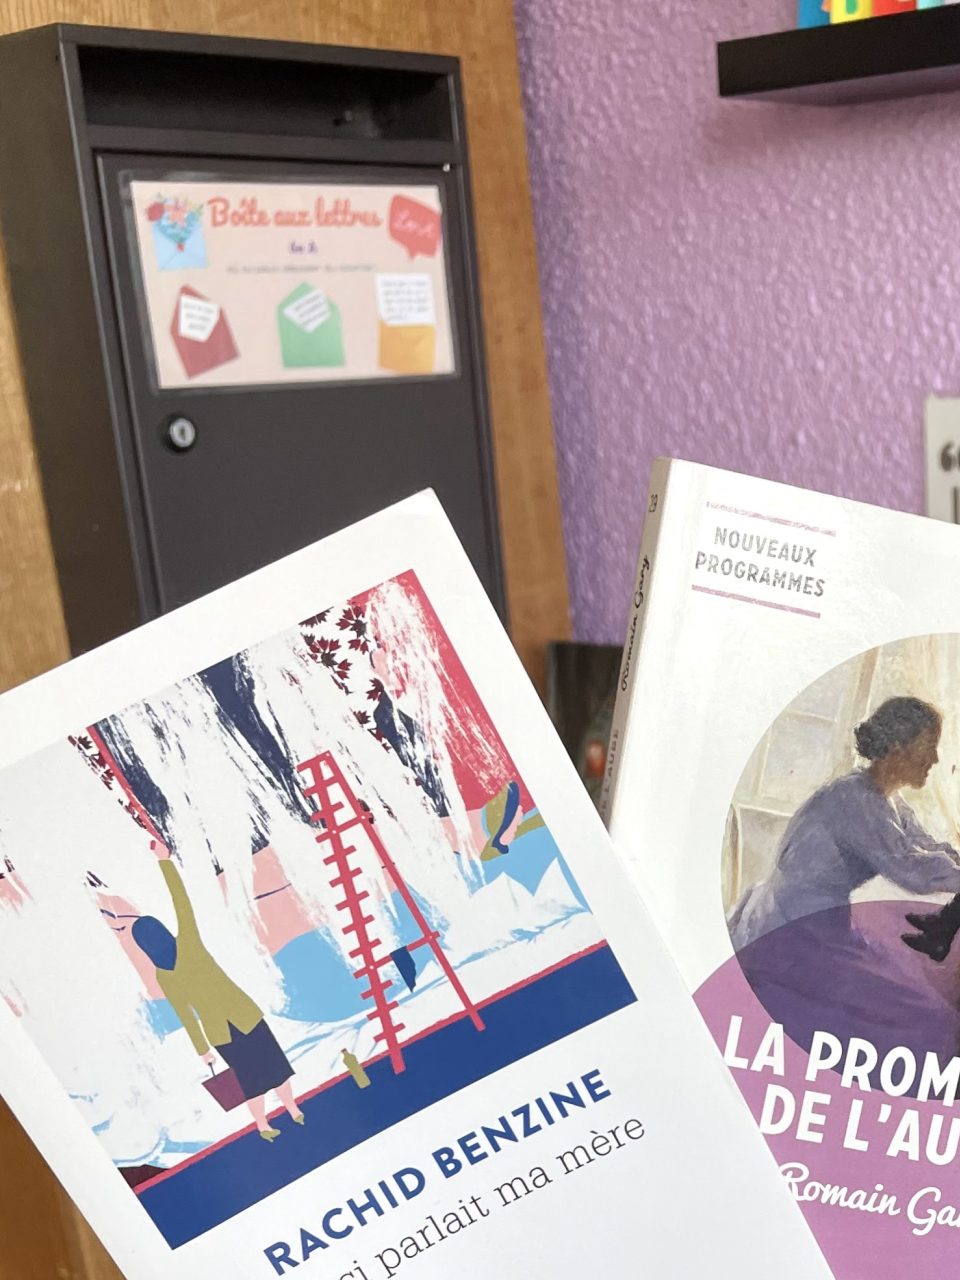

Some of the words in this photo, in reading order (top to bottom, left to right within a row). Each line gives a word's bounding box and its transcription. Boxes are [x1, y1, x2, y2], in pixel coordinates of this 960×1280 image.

[208, 196, 270, 227] Boîte
[274, 209, 312, 227] aux
[315, 195, 382, 227] lettres
[694, 551, 826, 598] PROGRAMMES
[714, 526, 817, 567] NOUVEAUX
[620, 612, 639, 692] Romain
[633, 554, 651, 611] Gary
[723, 1014, 785, 1077] LA
[759, 1083, 832, 1144] DE
[263, 1166, 427, 1277] RACHID
[431, 1068, 612, 1180] BENZINE
[374, 1194, 490, 1280] parlait
[493, 1166, 554, 1208] ma
[555, 1117, 646, 1175] mère
[779, 1161, 901, 1217] Romain
